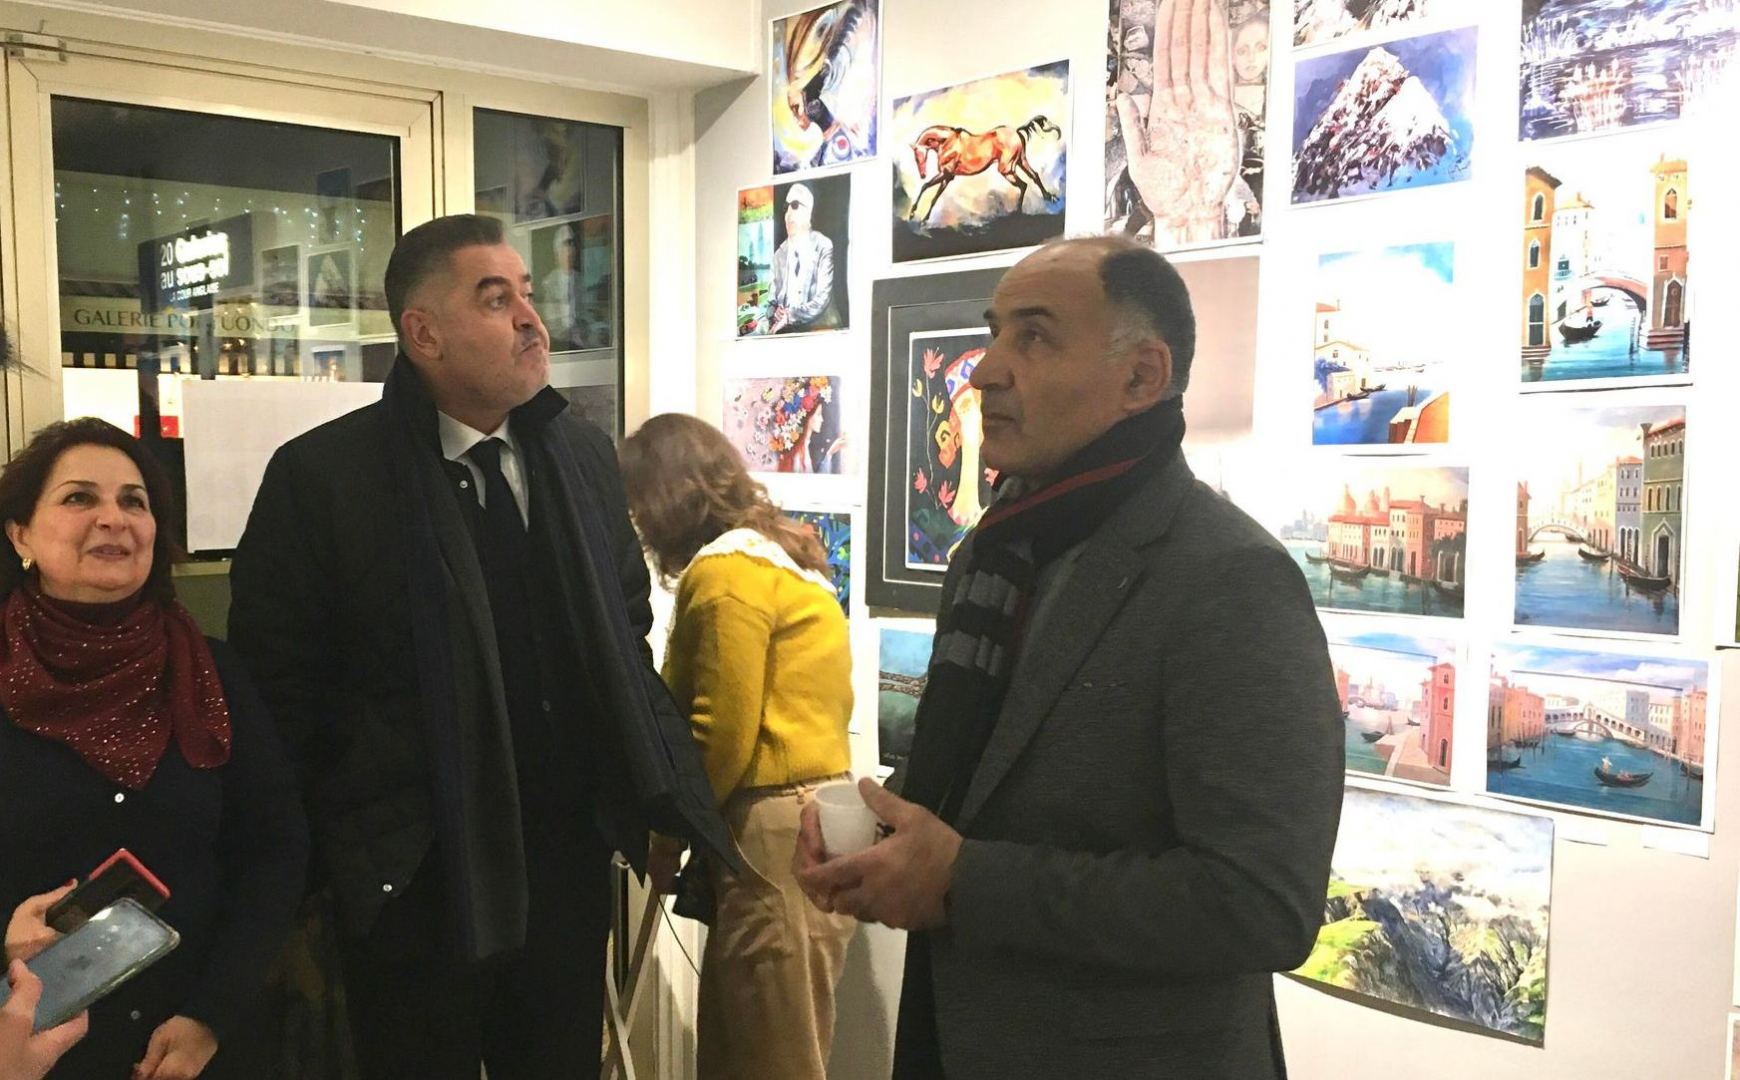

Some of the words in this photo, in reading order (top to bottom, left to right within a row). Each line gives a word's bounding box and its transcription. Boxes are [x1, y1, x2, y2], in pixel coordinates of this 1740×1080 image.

[161, 242, 174, 267] 20
[161, 270, 174, 290] au
[74, 308, 159, 328] GALERIE
